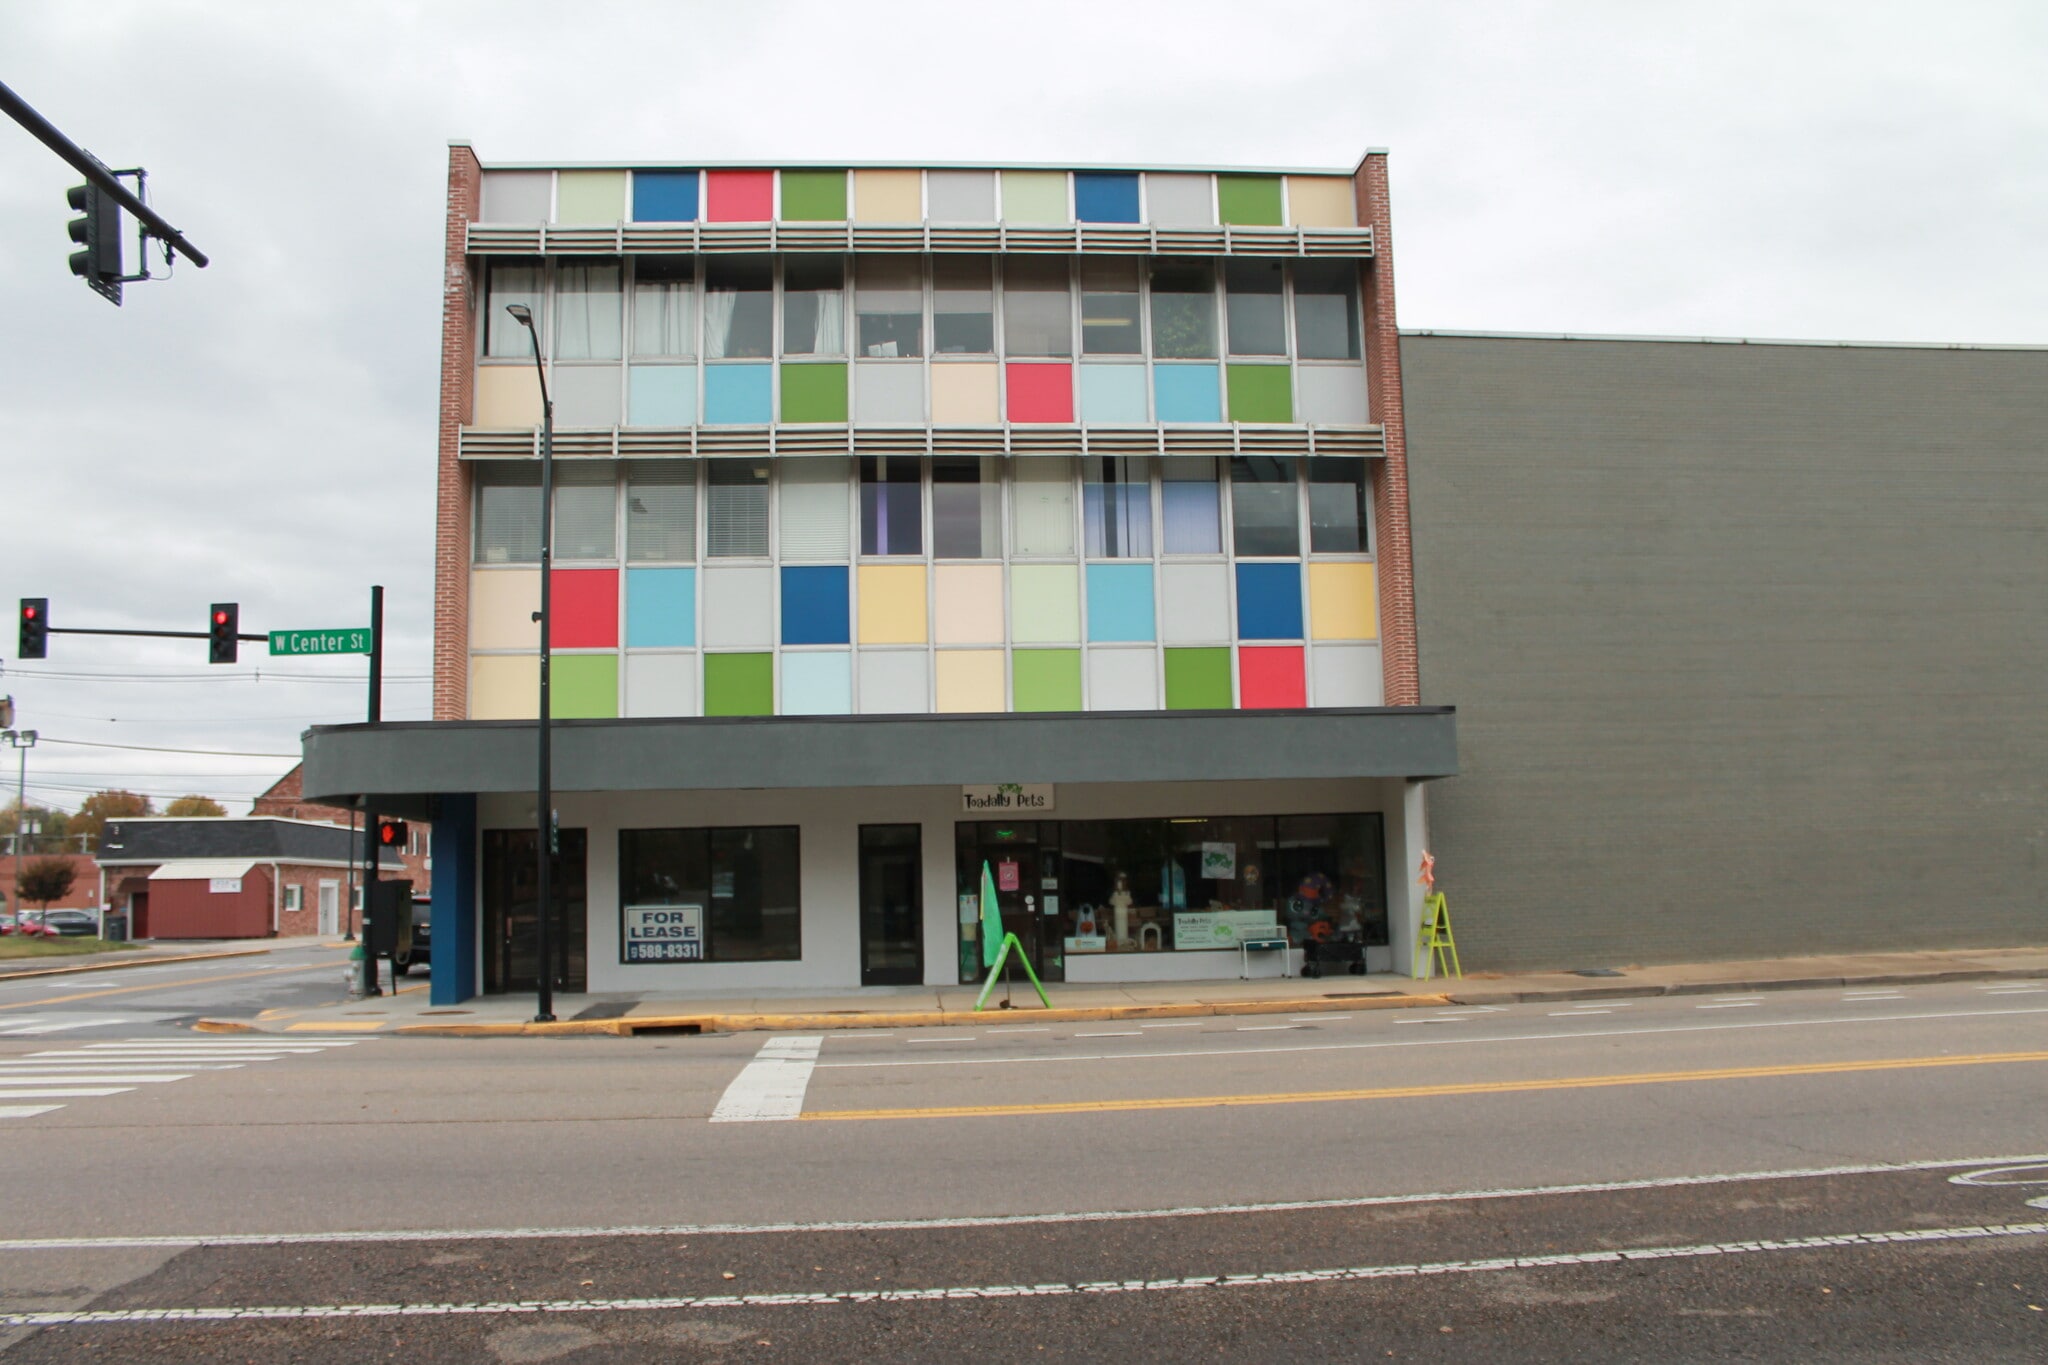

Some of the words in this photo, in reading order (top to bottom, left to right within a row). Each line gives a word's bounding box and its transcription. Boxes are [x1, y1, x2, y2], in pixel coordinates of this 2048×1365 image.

[275, 635, 286, 651] W
[290, 633, 344, 652] Center
[350, 632, 364, 649] St
[964, 793, 1010, 809] Toadally
[1016, 793, 1045, 807] Pets
[642, 912, 684, 924] FOR
[630, 926, 697, 938] LEASE
